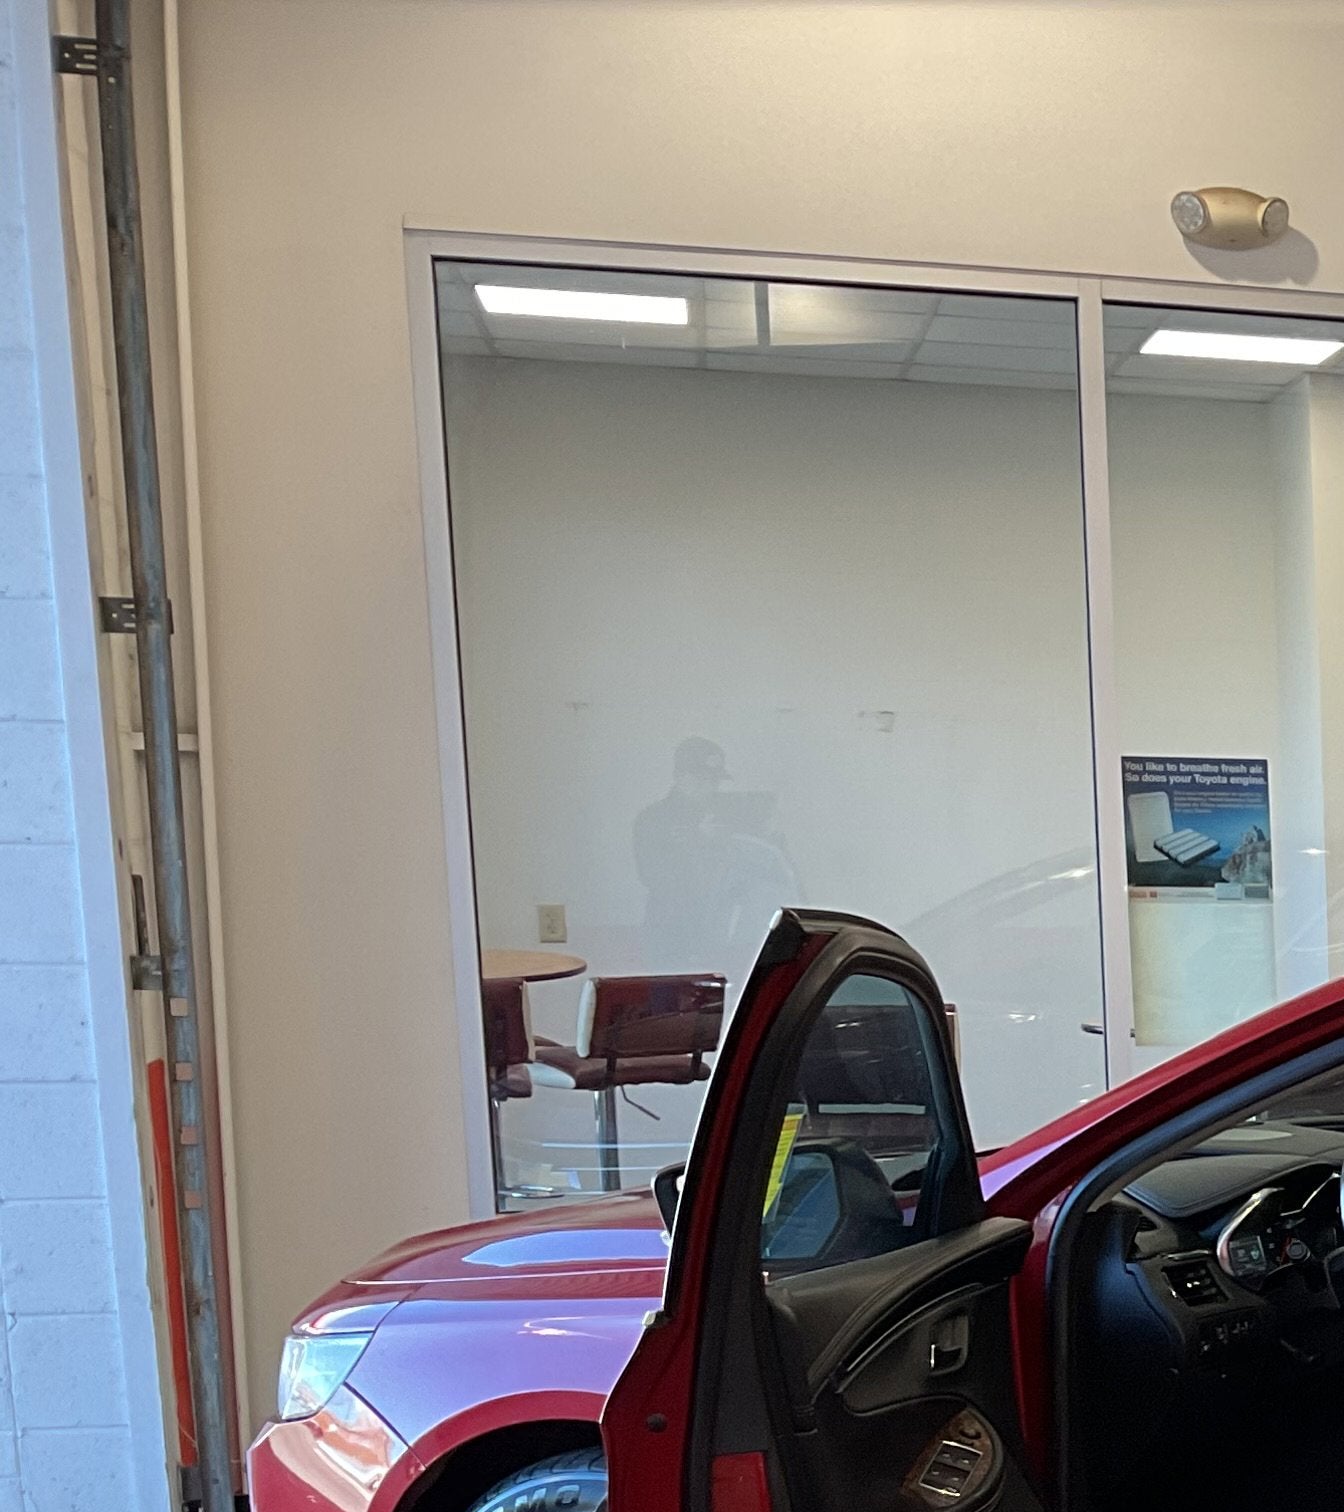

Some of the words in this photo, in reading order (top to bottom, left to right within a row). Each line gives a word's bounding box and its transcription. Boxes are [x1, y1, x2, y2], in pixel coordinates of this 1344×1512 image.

[1124, 761, 1143, 771] You
[1145, 762, 1164, 772] like
[1167, 763, 1177, 772] to
[1180, 763, 1219, 773] breathe
[1221, 764, 1248, 773] fresh
[1124, 772, 1140, 782] So
[1141, 773, 1167, 782] does
[1169, 774, 1192, 785] your
[1193, 774, 1228, 785] Toyota
